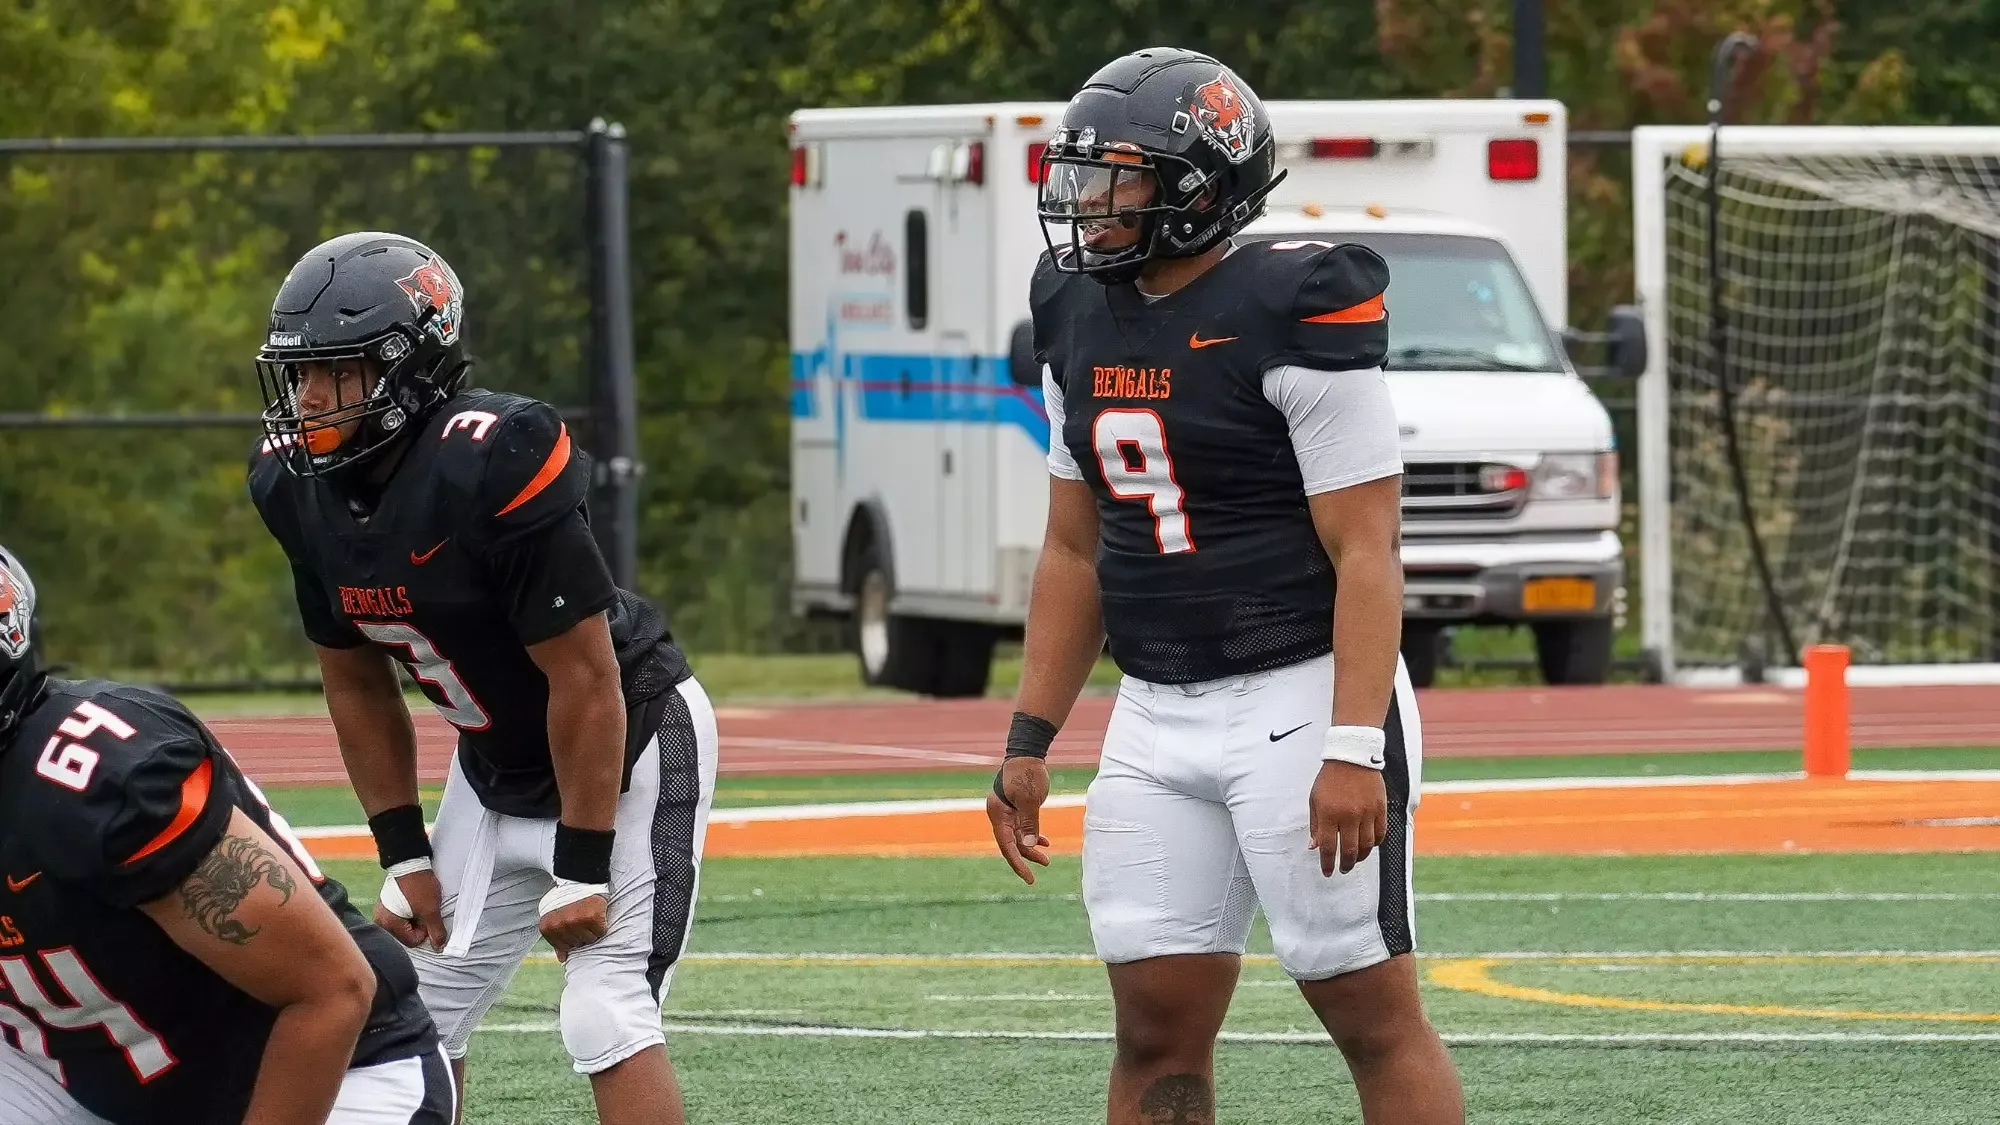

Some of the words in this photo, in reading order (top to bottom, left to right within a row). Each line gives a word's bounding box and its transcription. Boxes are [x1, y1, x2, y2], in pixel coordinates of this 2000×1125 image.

[270, 334, 301, 346] Riddell
[1092, 366, 1171, 399] BENGALS
[441, 410, 498, 442] 3
[1092, 407, 1197, 554] 9
[338, 586, 413, 616] BENGALS
[353, 620, 492, 732] 3
[35, 699, 138, 792] 64
